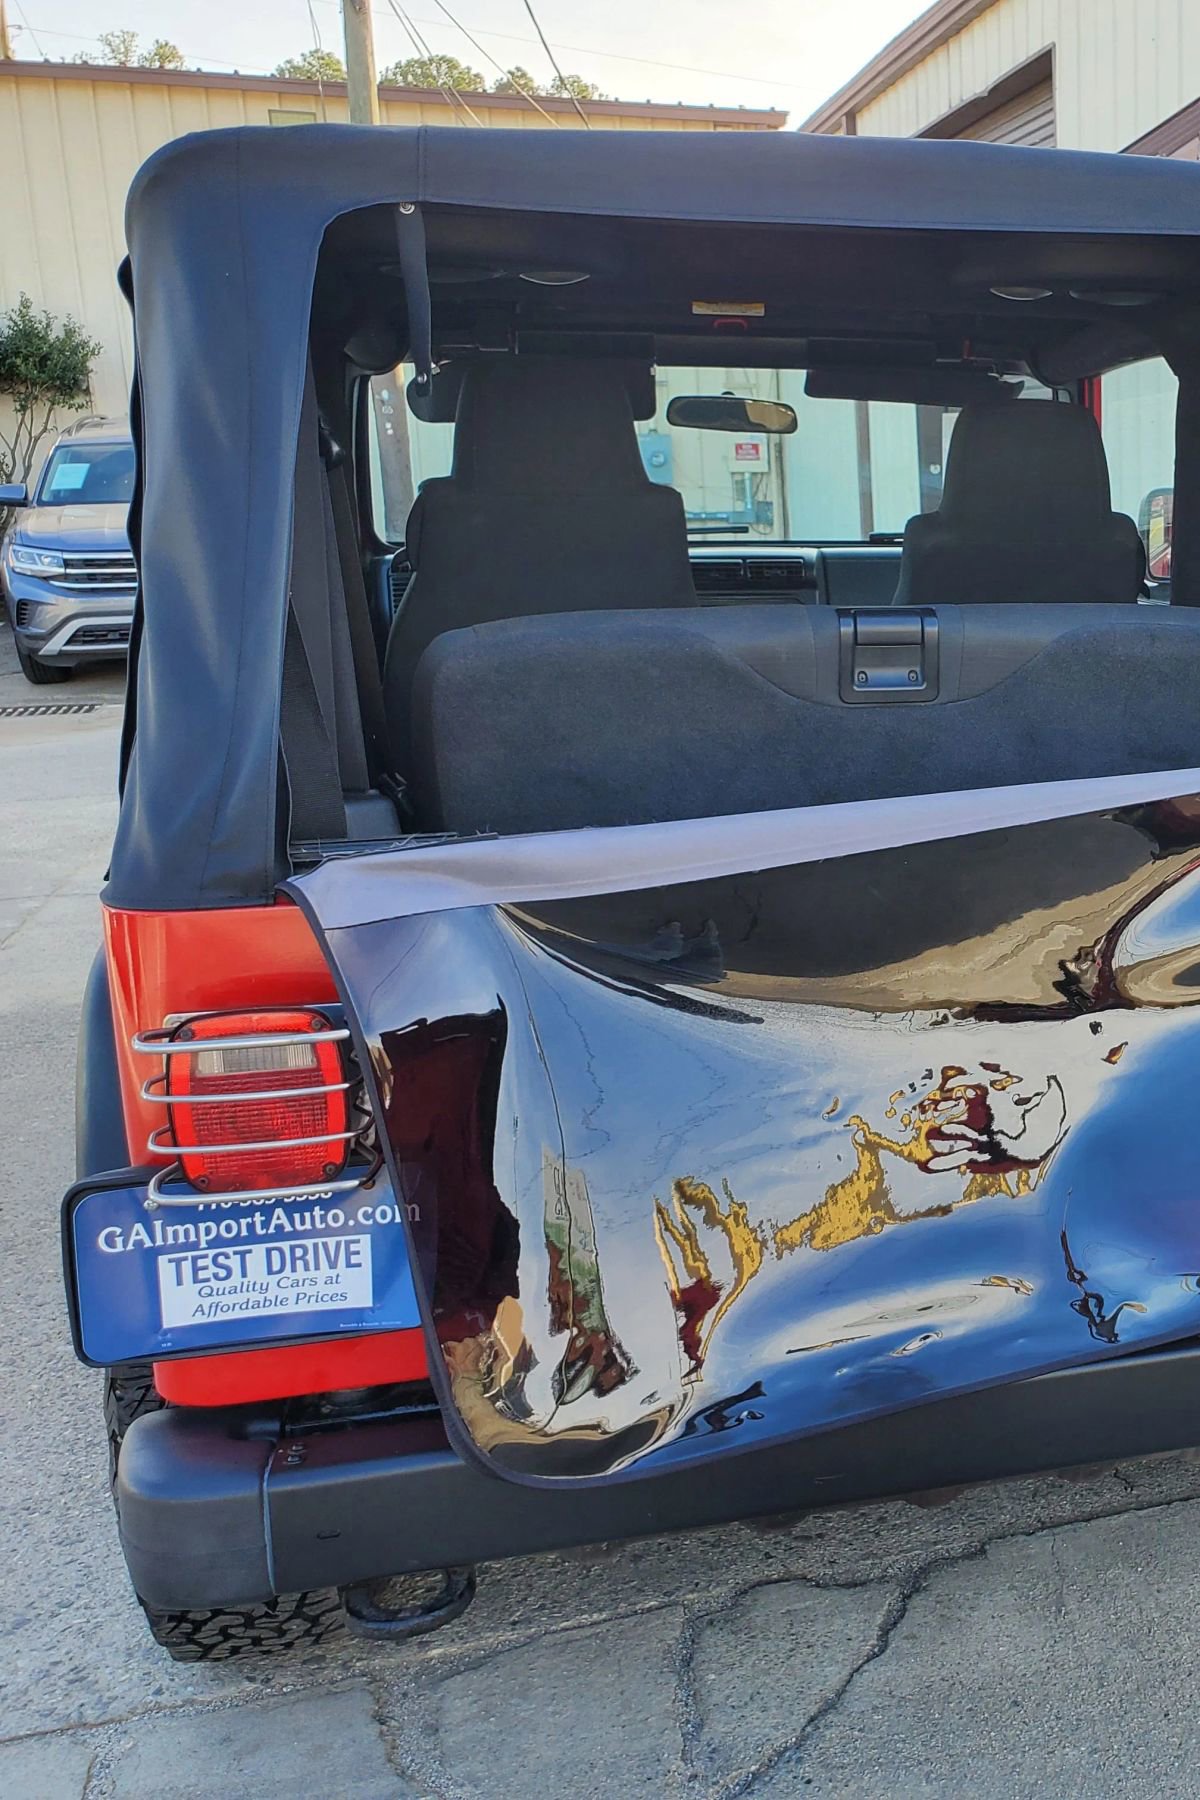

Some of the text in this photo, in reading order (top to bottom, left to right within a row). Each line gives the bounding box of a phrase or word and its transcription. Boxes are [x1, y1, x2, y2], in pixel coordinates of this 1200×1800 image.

[99, 1200, 421, 1253] GAImportAuto.com
[168, 1238, 362, 1287] TEST DRIVE
[192, 1289, 348, 1318] Affordable Prices
[198, 1272, 342, 1300] Quality Cars at
